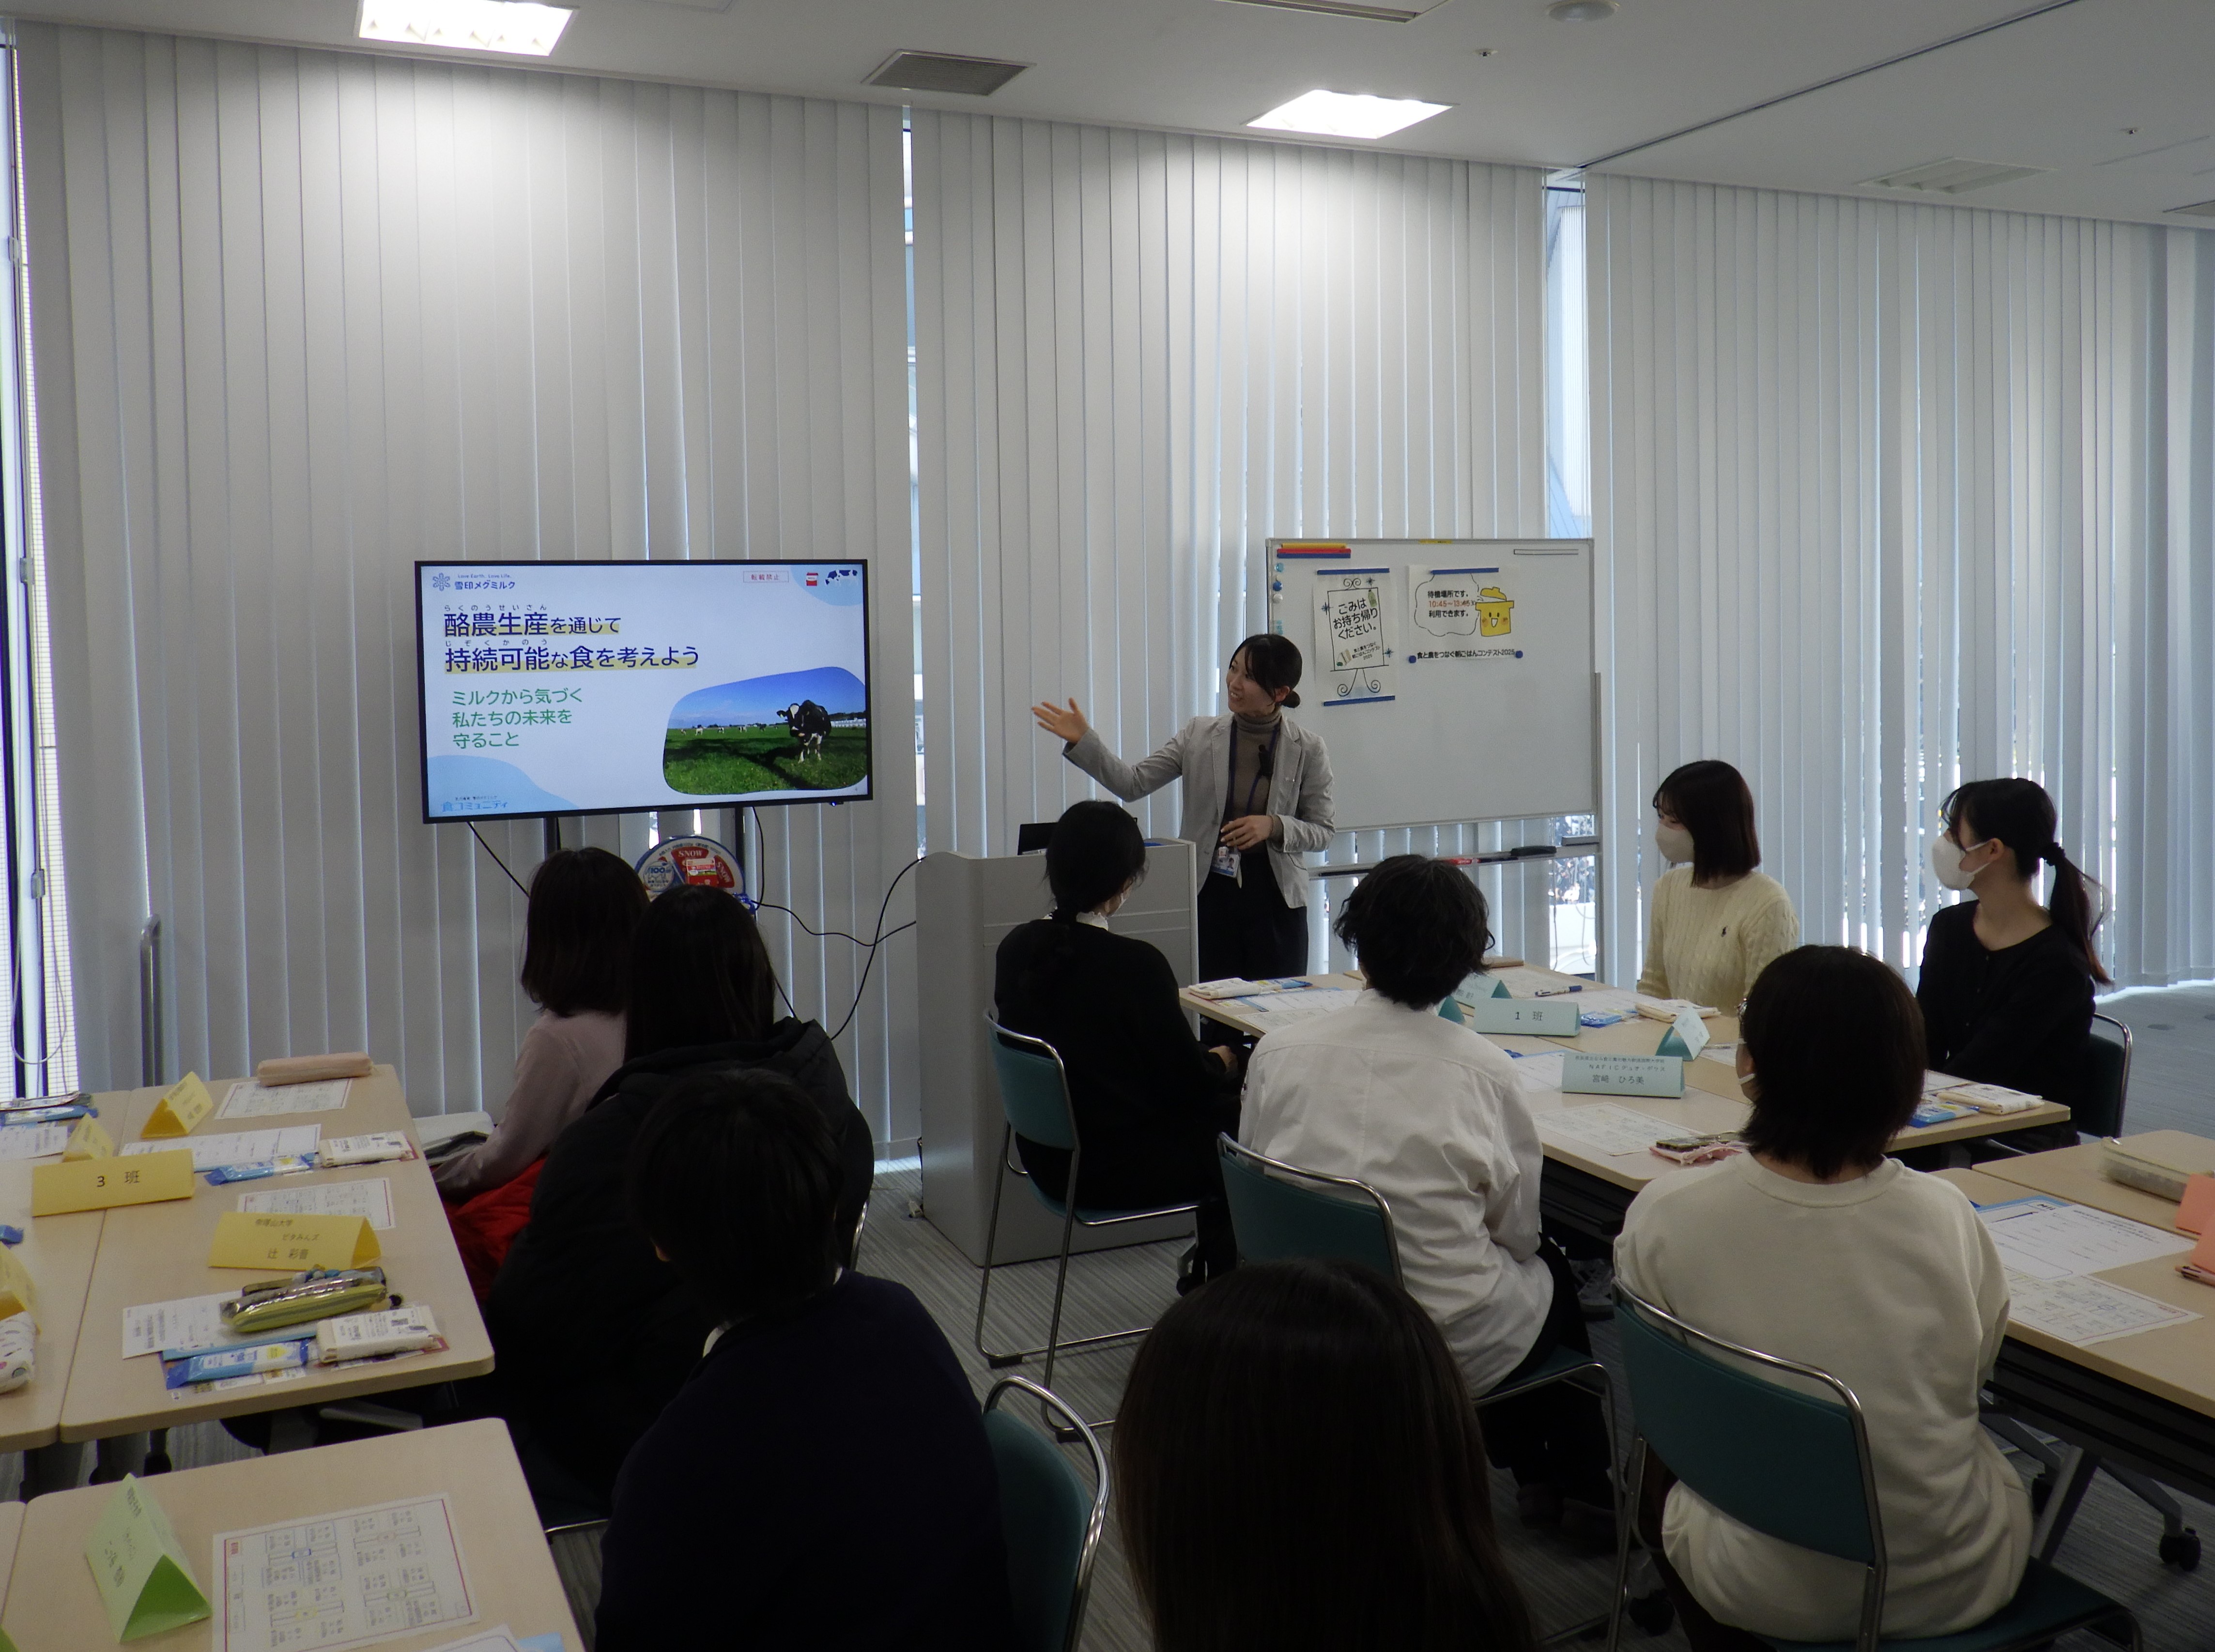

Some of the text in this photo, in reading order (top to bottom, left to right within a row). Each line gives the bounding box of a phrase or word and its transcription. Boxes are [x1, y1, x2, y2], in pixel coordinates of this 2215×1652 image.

[455, 580, 515, 590] 雪印メグミルク
[1338, 598, 1367, 614] ごみは
[444, 612, 621, 637] 酪農生産を通じて
[1333, 608, 1378, 629] お持ち帰り
[1338, 623, 1376, 640] ください。
[445, 645, 699, 672] 持続可能な食を考えよう
[452, 688, 582, 705] ミルクから気づく
[452, 709, 572, 728] 私たちの未来を
[453, 732, 519, 749] 守ること
[1515, 1011, 1543, 1021] 1 班
[97, 1170, 140, 1187] 3 班
